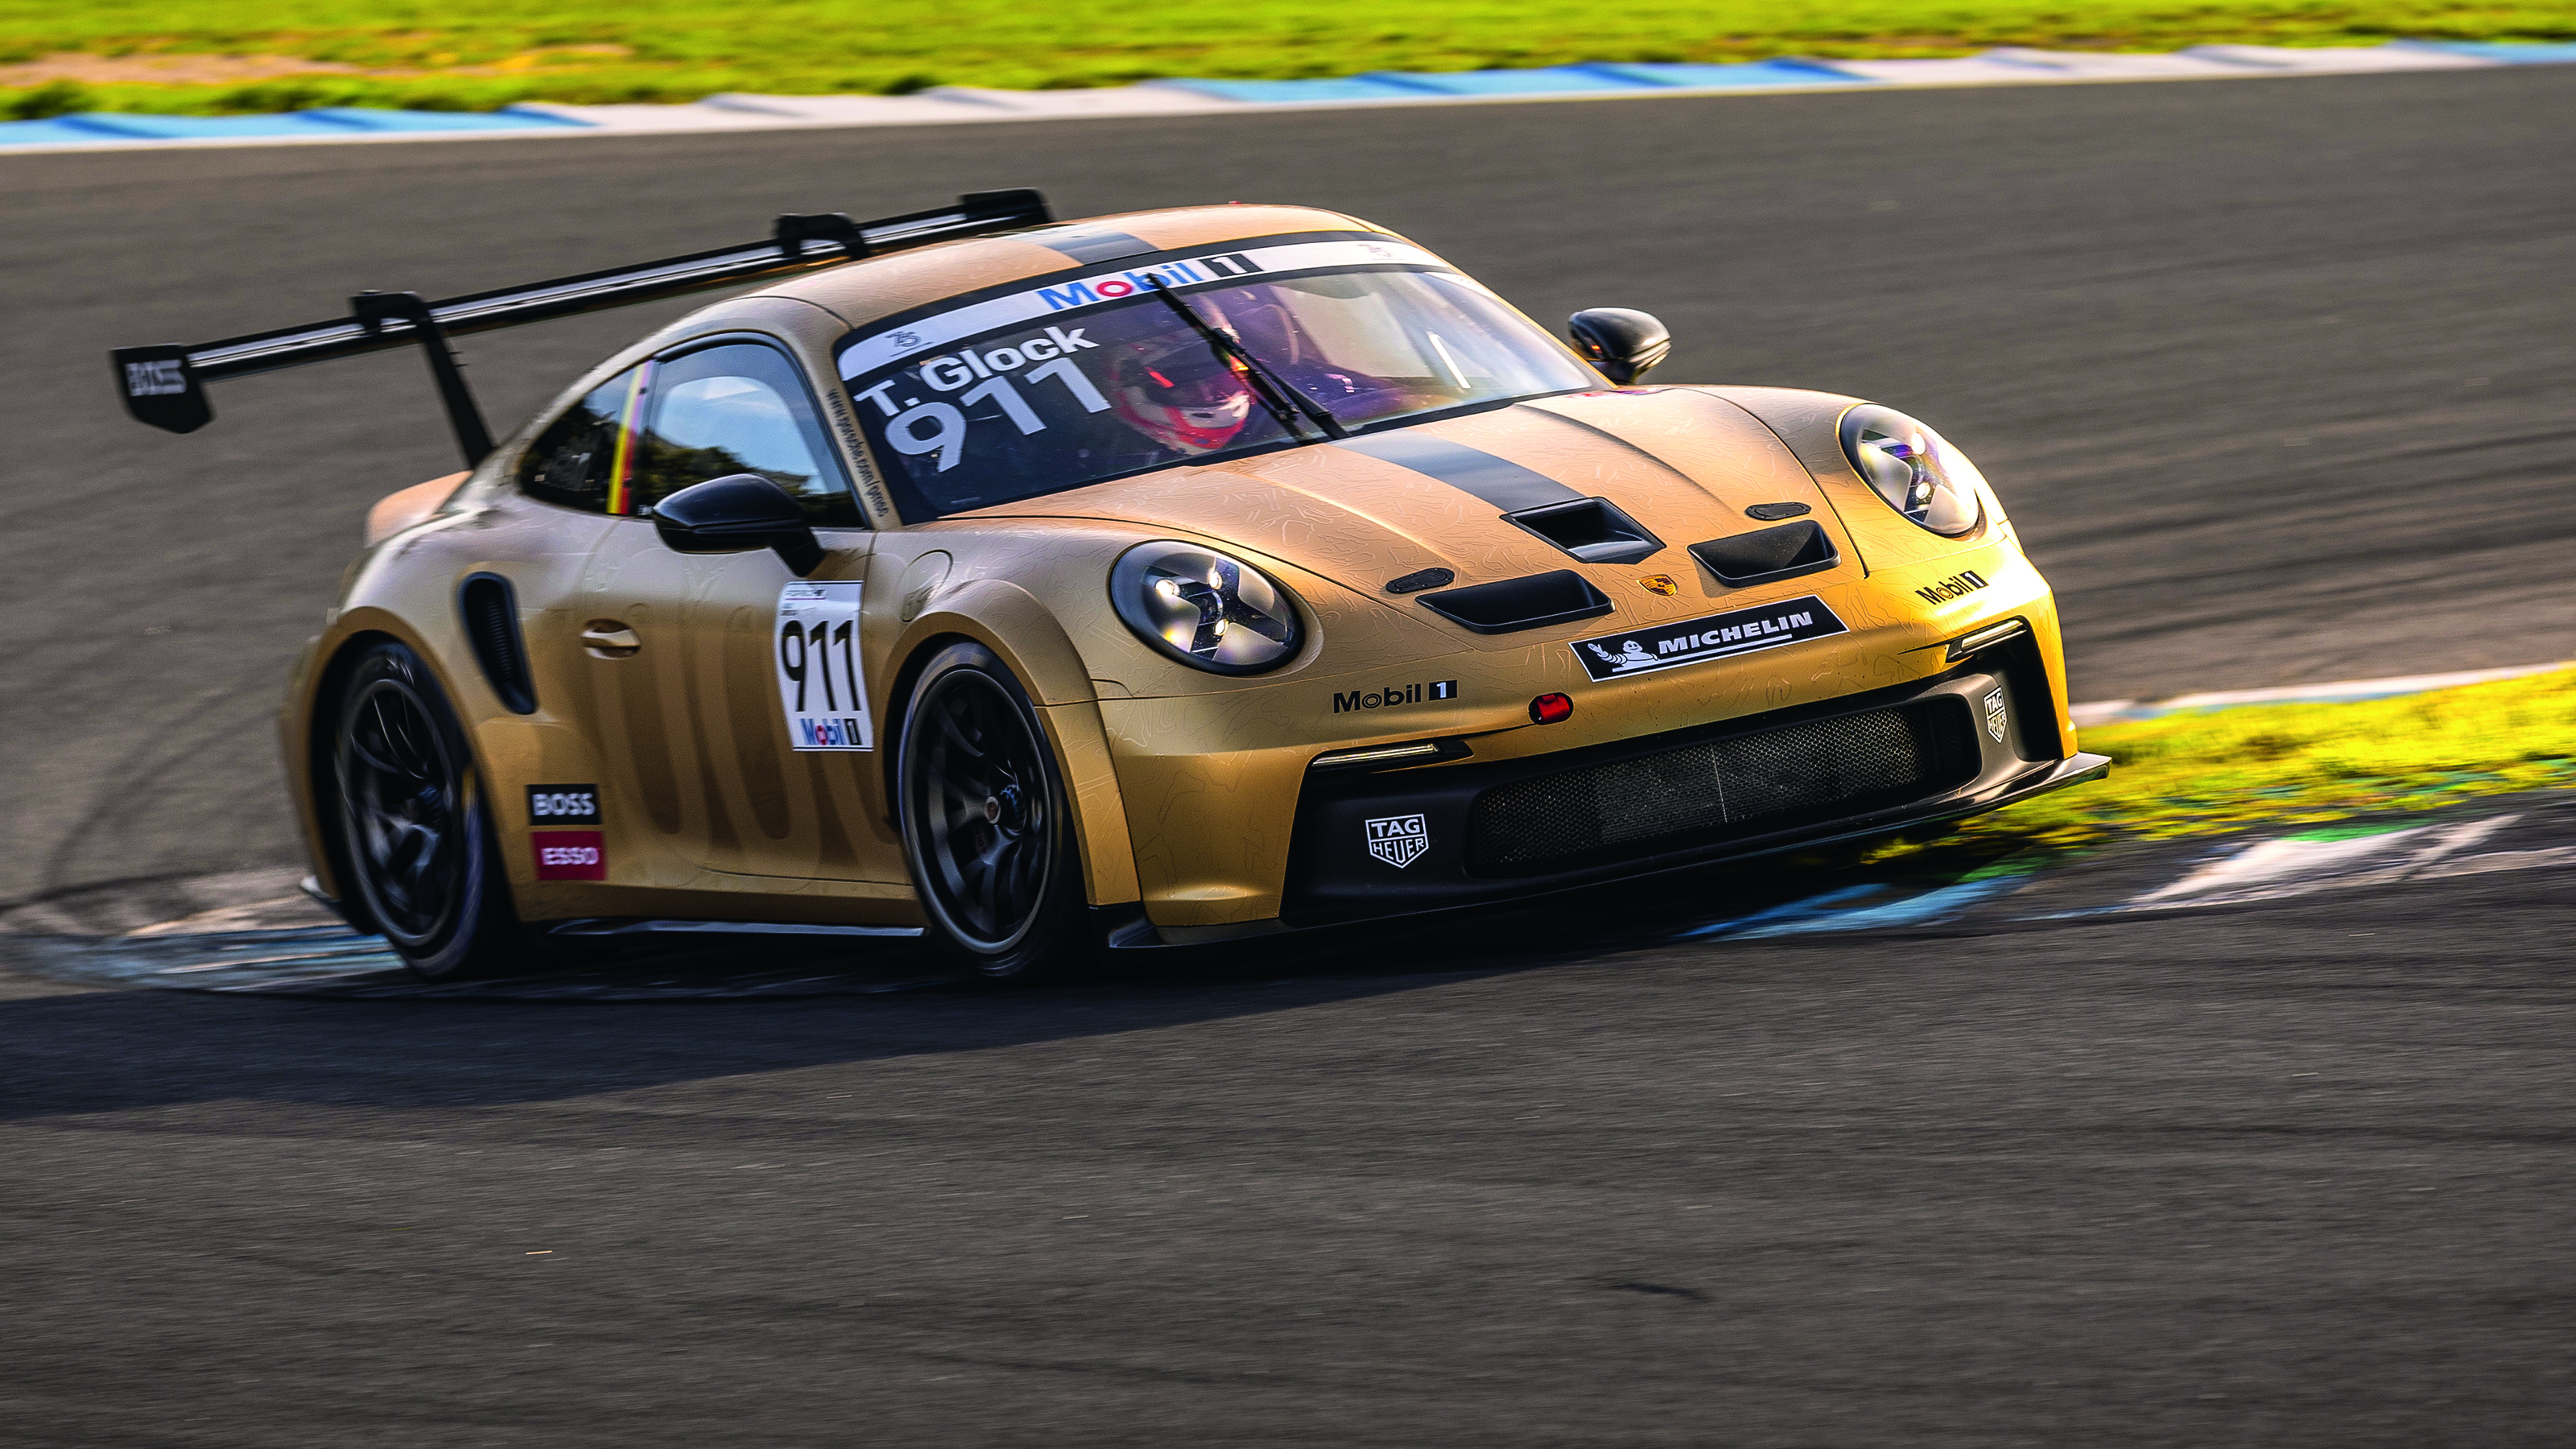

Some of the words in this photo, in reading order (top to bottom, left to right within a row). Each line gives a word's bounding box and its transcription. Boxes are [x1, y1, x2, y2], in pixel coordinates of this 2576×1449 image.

[1037, 262, 1204, 311] Mobil
[853, 379, 920, 416] T.
[919, 326, 1100, 392] Glock
[886, 357, 1112, 473] 911
[1914, 576, 1974, 605] Mobil
[1658, 611, 1813, 654] MICHELIN
[781, 619, 861, 712] 911
[1333, 683, 1422, 714] Mobil
[1986, 692, 2003, 714] TAG
[800, 718, 845, 745] Mobil
[1988, 712, 2006, 738] HEUER
[532, 793, 596, 815] BOSS
[1371, 818, 1421, 838] TAG
[540, 847, 600, 865] ESSO
[1373, 838, 1424, 864] HEUER
